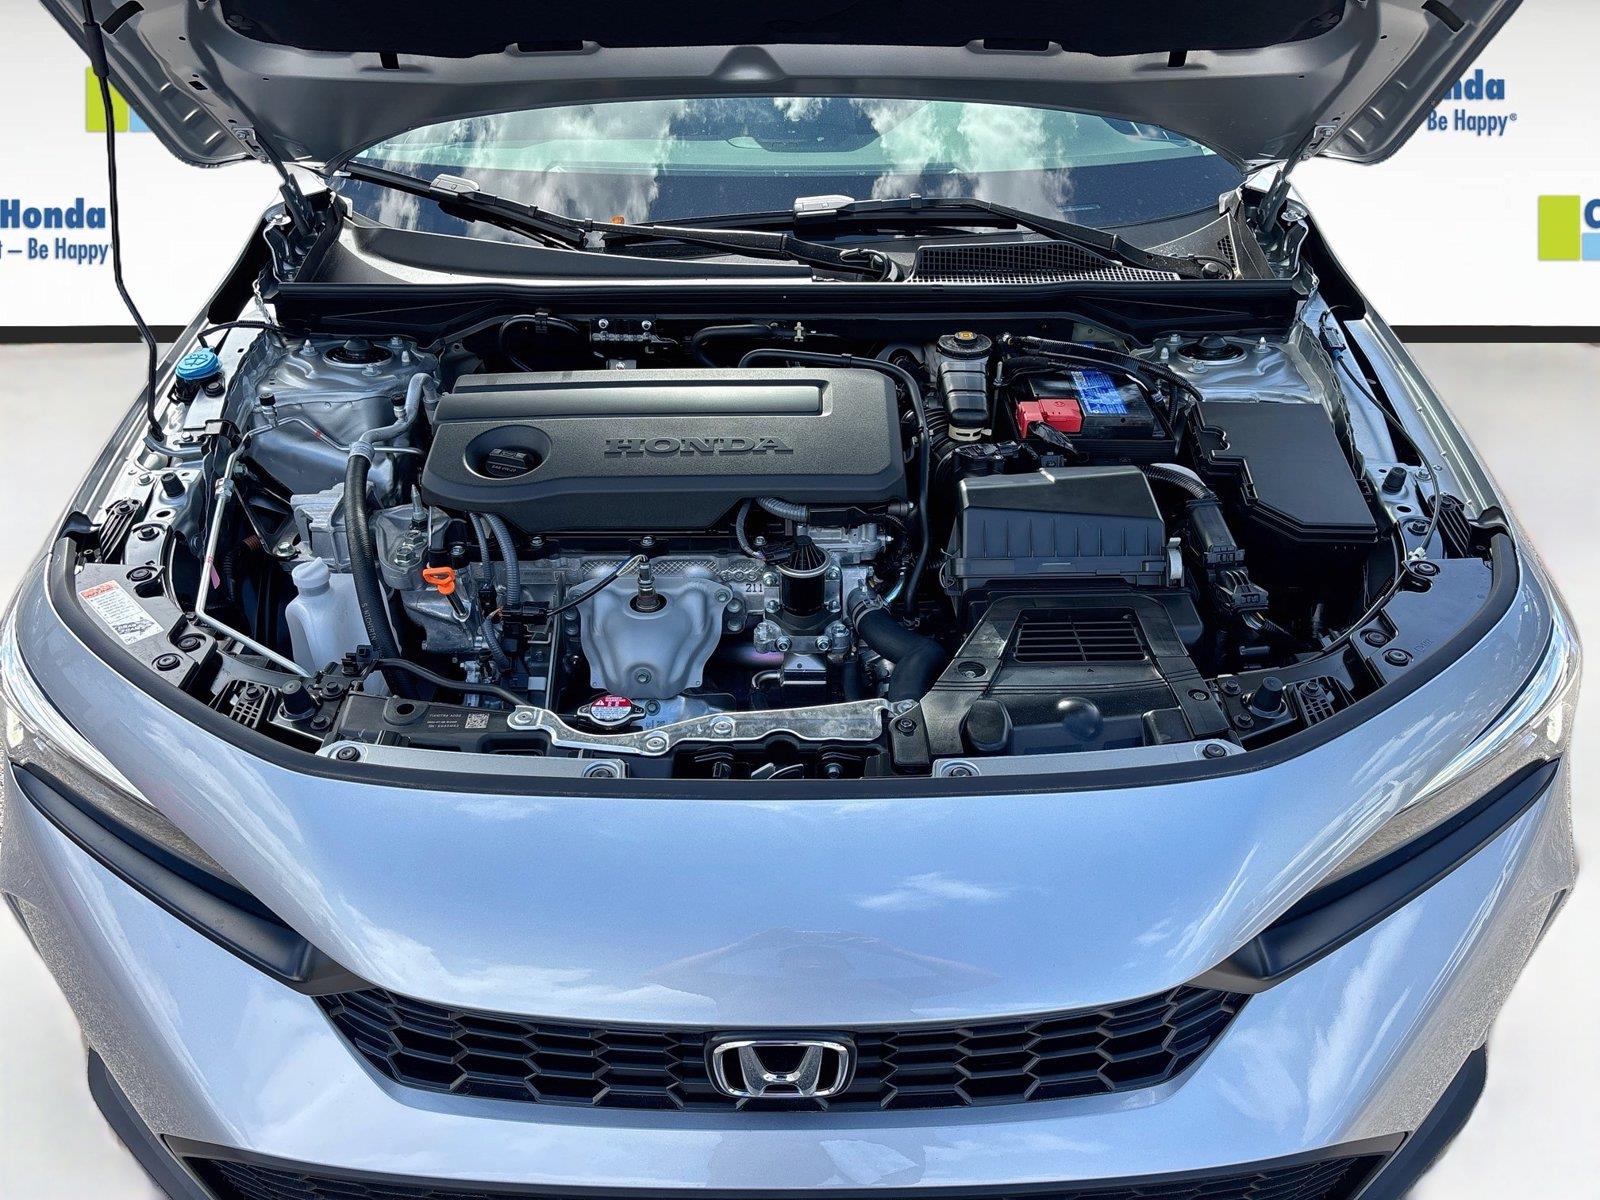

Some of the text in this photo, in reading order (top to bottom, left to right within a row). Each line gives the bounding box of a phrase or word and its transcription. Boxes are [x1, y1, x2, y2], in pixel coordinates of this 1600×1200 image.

[1427, 109, 1448, 131] Be
[0, 197, 106, 229] Honda
[28, 237, 49, 259] Be
[604, 437, 794, 458] HONDA
[745, 583, 763, 593] 211
